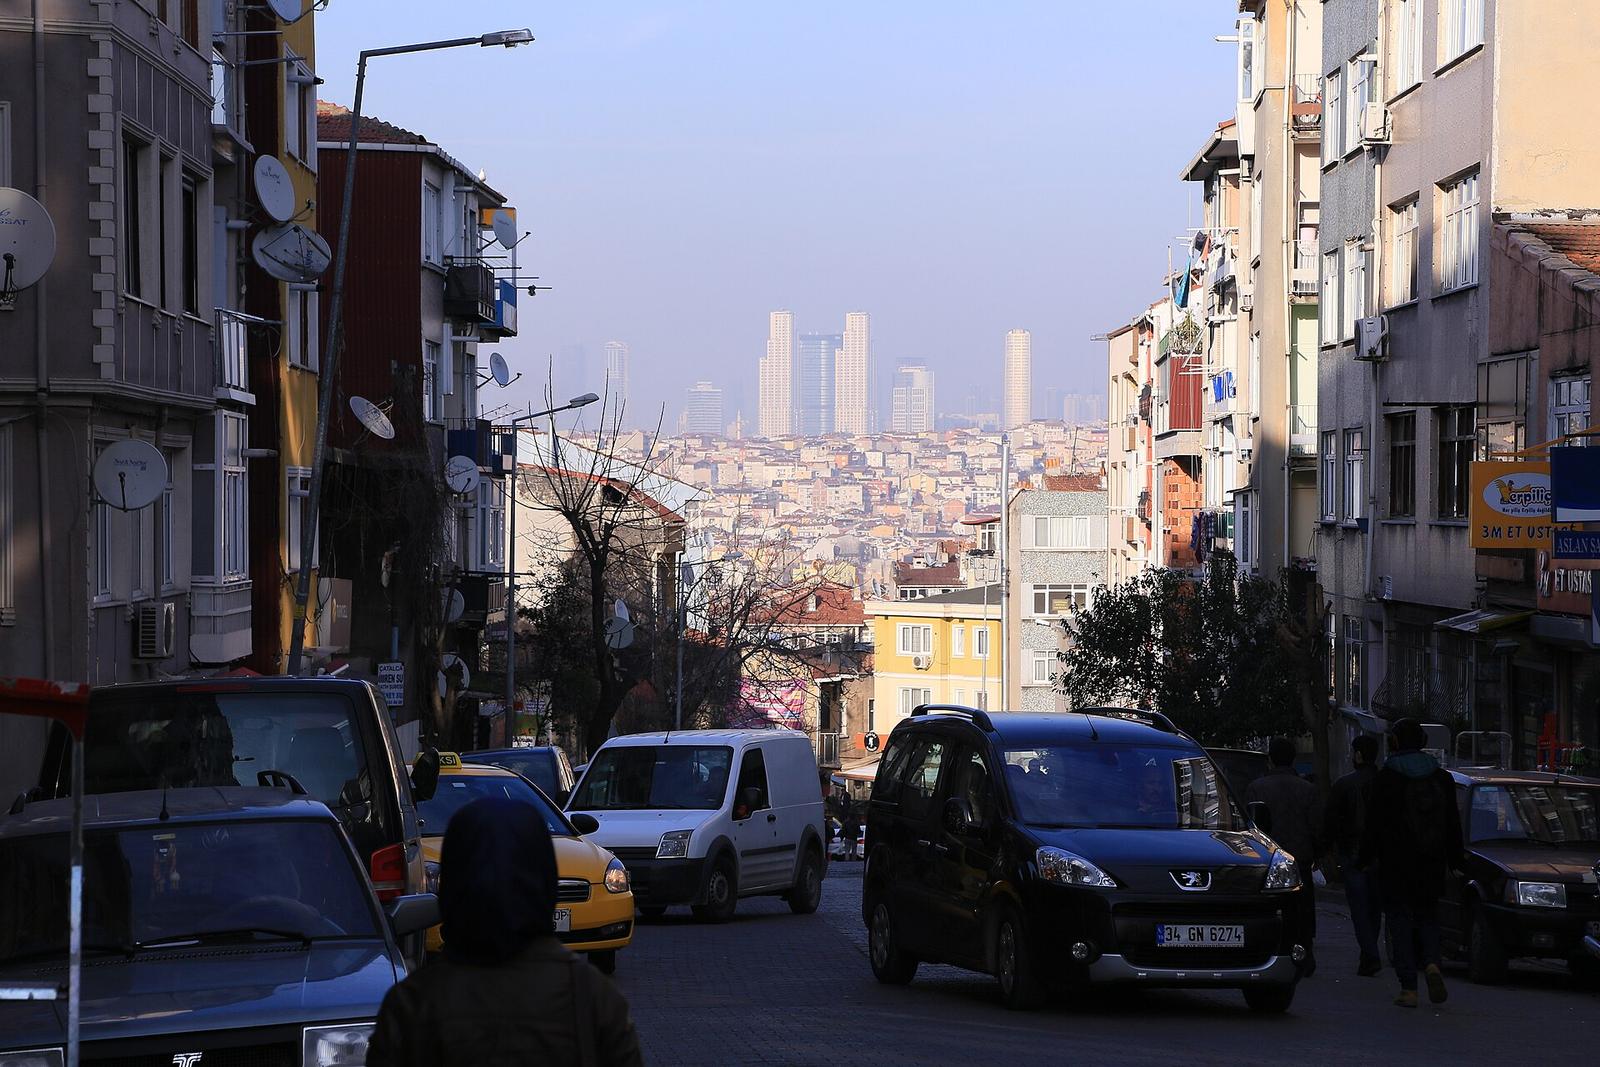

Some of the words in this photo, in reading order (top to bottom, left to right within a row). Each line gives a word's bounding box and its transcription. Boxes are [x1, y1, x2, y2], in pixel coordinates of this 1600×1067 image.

[1482, 525, 1502, 538] 3M
[1507, 525, 1522, 538] ET
[1554, 568, 1565, 592] ET
[1567, 569, 1592, 594] USTAS
[1165, 926, 1181, 941] 34
[1188, 926, 1204, 941] GN
[1210, 926, 1241, 941] 6274
